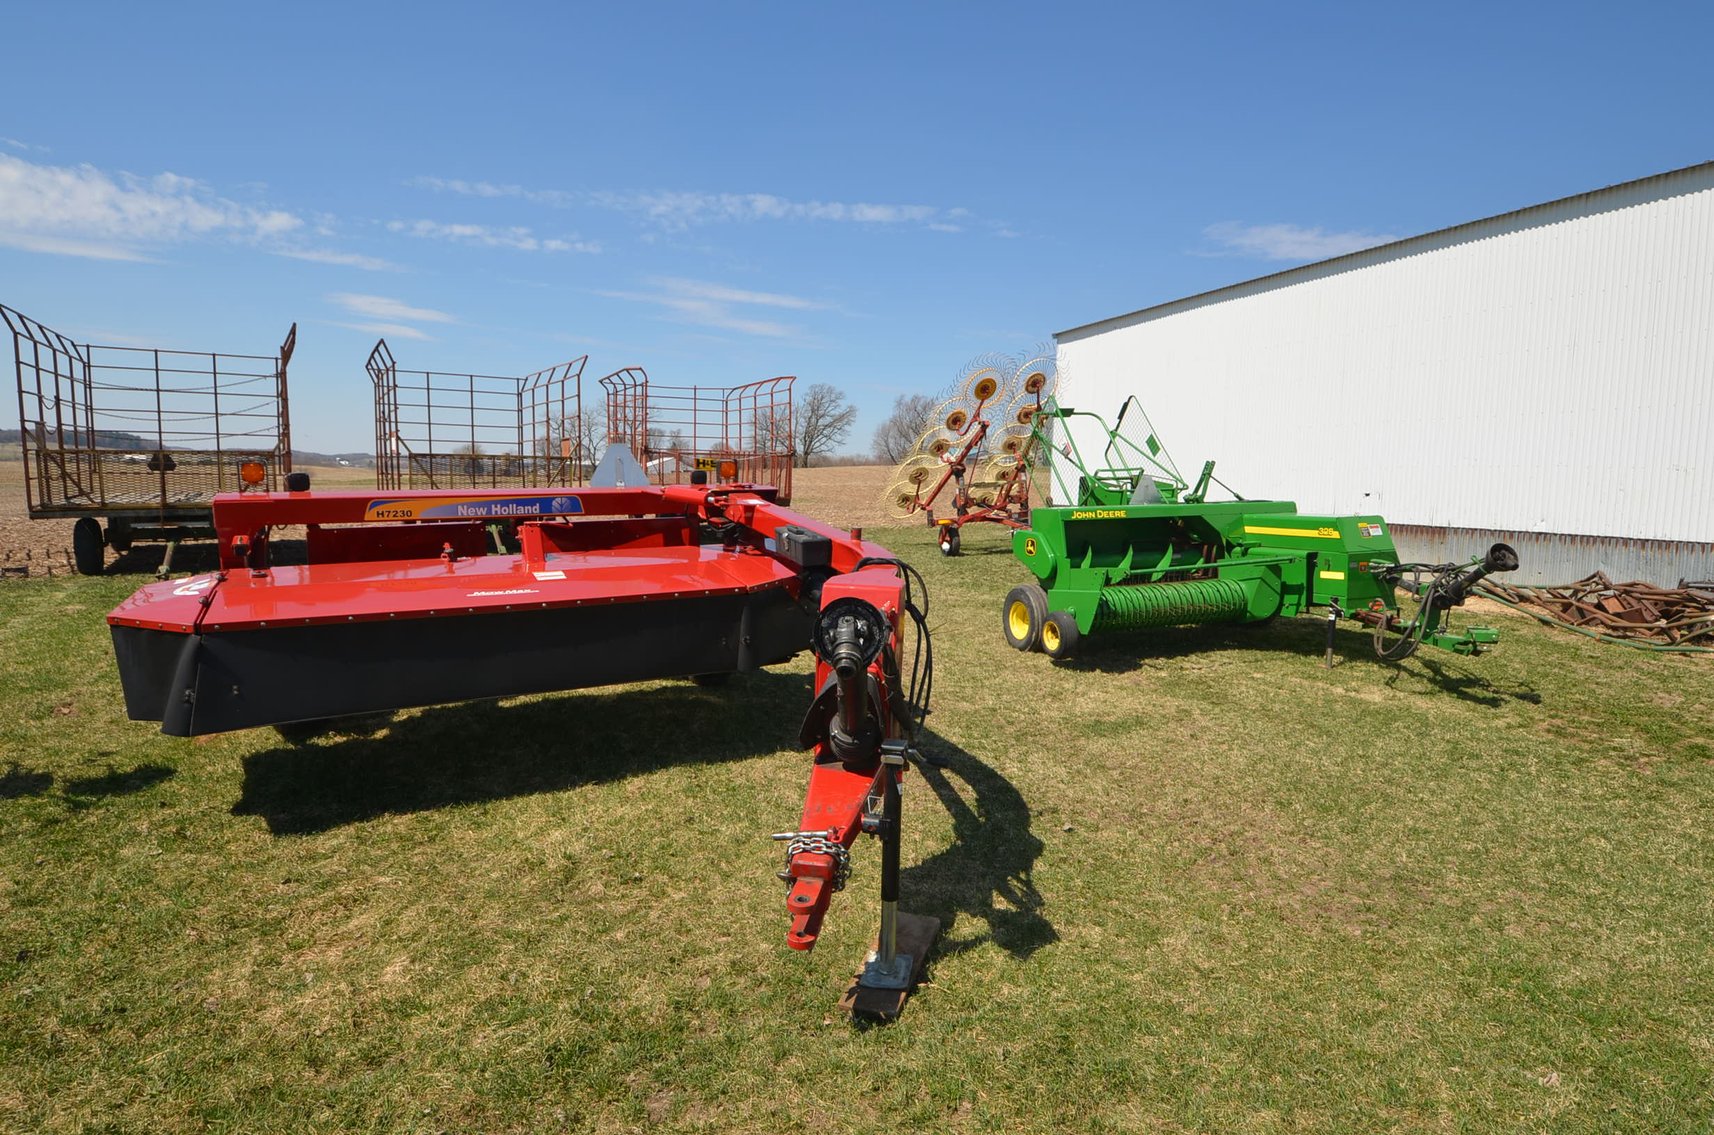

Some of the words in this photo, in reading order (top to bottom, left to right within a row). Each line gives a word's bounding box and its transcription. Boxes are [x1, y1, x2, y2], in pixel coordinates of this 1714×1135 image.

[376, 509, 413, 518] H7230
[457, 504, 488, 516] New
[491, 503, 540, 515] Holland
[1071, 511, 1096, 519] JOHN
[1097, 510, 1127, 518] DEERE
